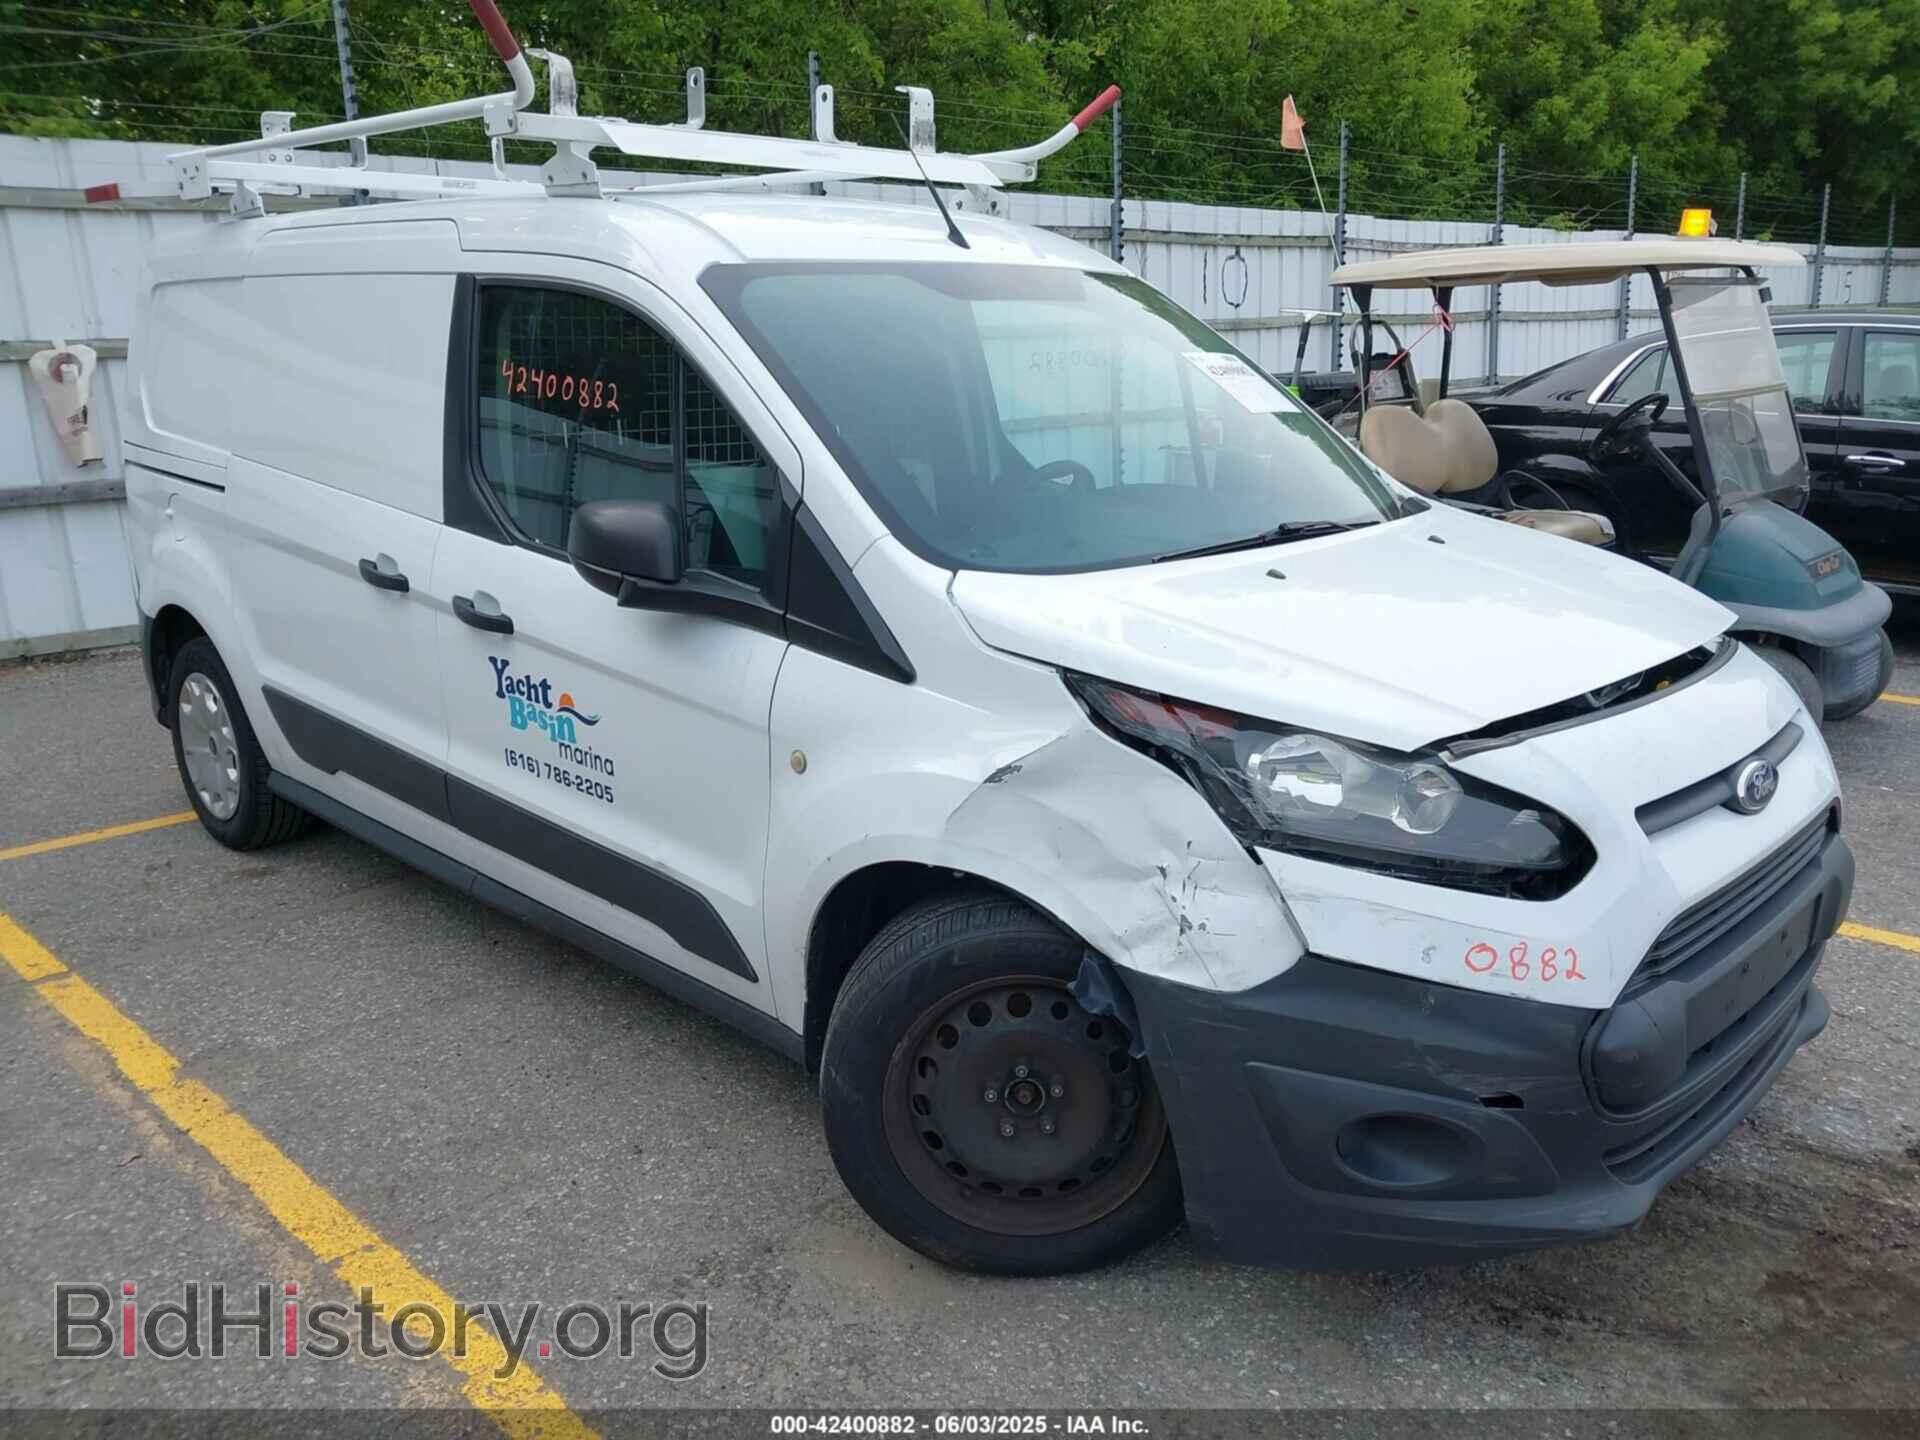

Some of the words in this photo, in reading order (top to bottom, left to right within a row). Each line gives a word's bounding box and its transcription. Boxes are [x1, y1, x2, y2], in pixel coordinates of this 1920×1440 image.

[502, 359, 620, 412] 42400882
[488, 656, 553, 708] Yacht
[509, 695, 577, 743] Basin
[505, 748, 540, 778] (616)
[544, 763, 614, 803] 786-2205
[559, 742, 615, 776] marina
[1464, 942, 1586, 981] 0882
